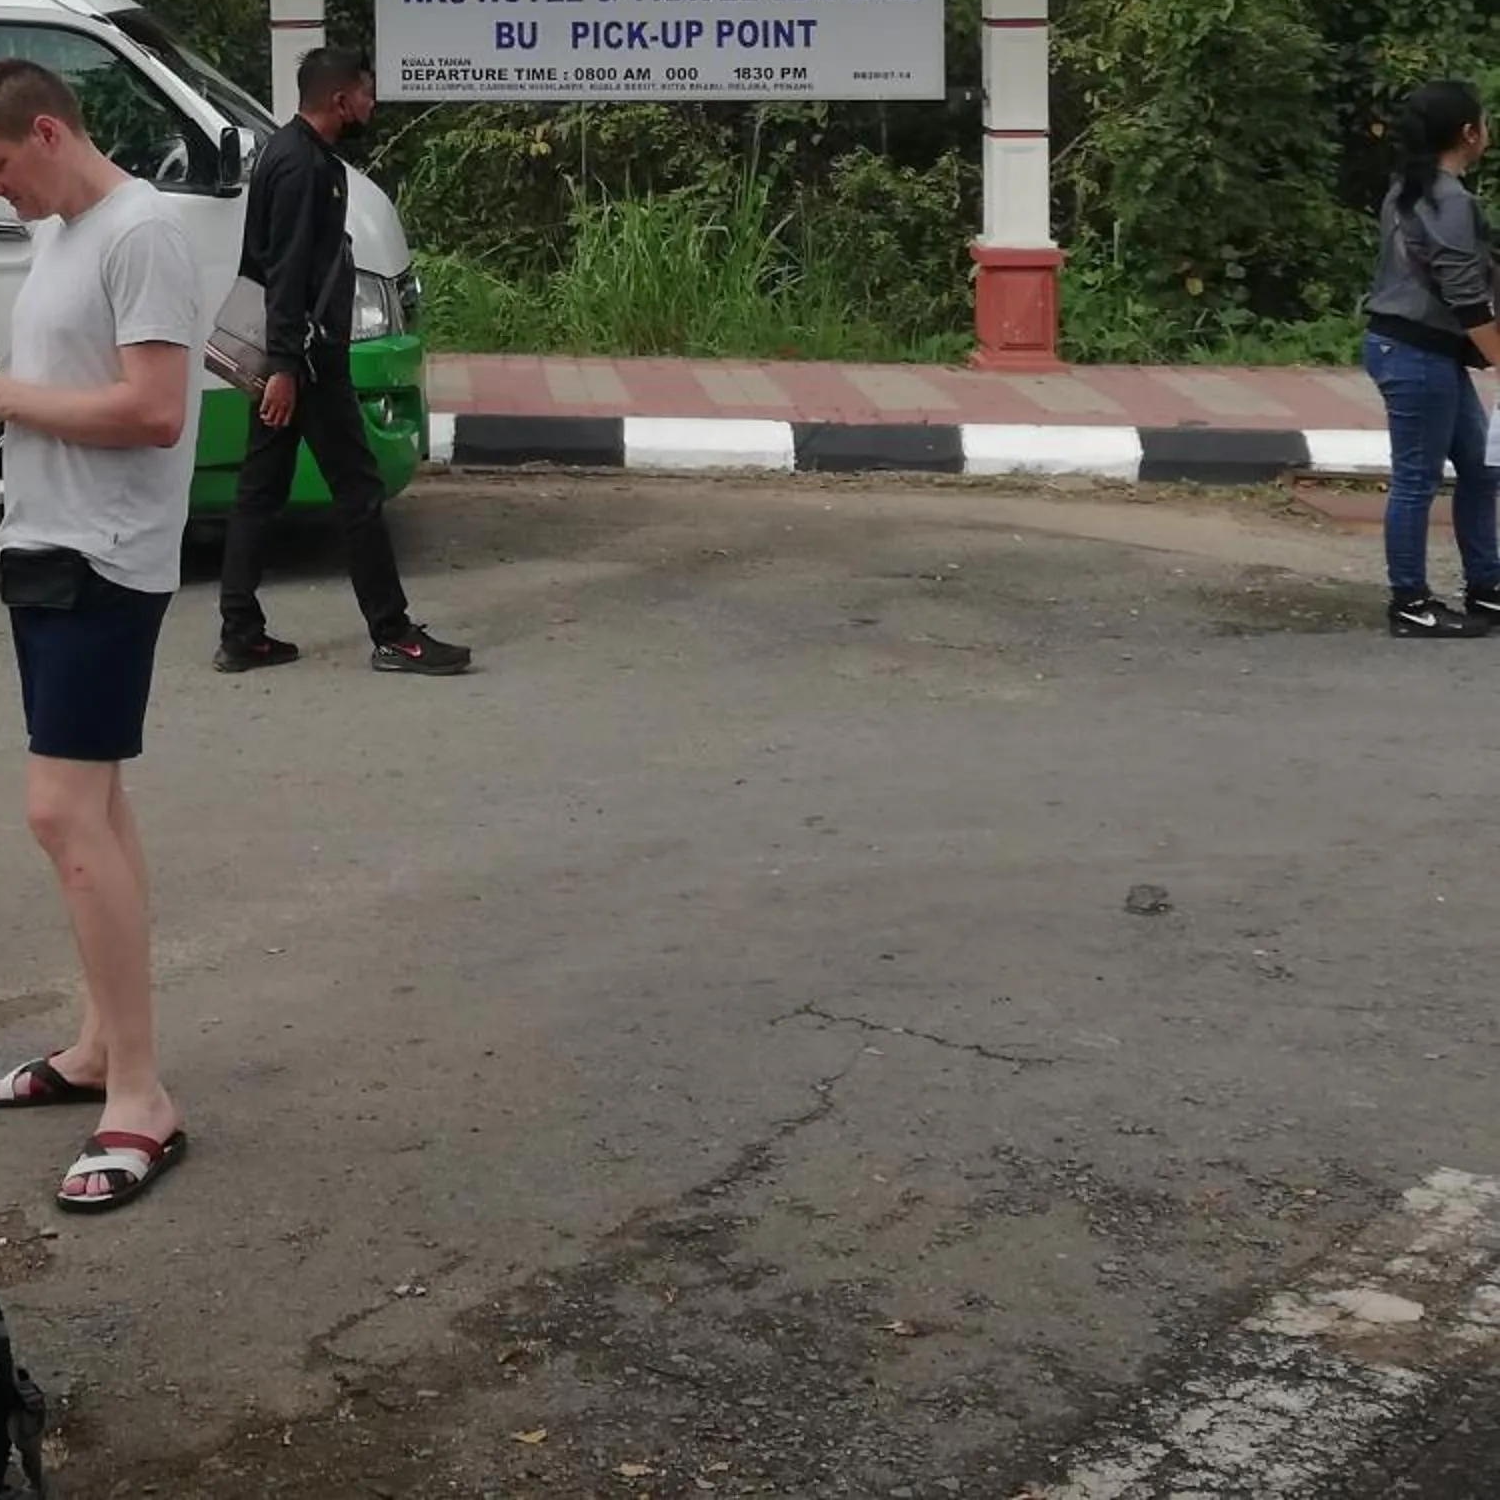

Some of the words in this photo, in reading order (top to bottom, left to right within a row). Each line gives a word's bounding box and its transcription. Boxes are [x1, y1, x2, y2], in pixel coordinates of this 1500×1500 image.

[571, 20, 703, 49] PICK-UP
[716, 19, 817, 49] POINT
[402, 58, 435, 67] KUALA
[401, 68, 509, 81] DEPARTURE
[514, 68, 557, 81] TIME
[574, 67, 617, 81] 0800
[623, 68, 651, 81] AM
[733, 67, 774, 80] 1830
[780, 67, 807, 80] PM
